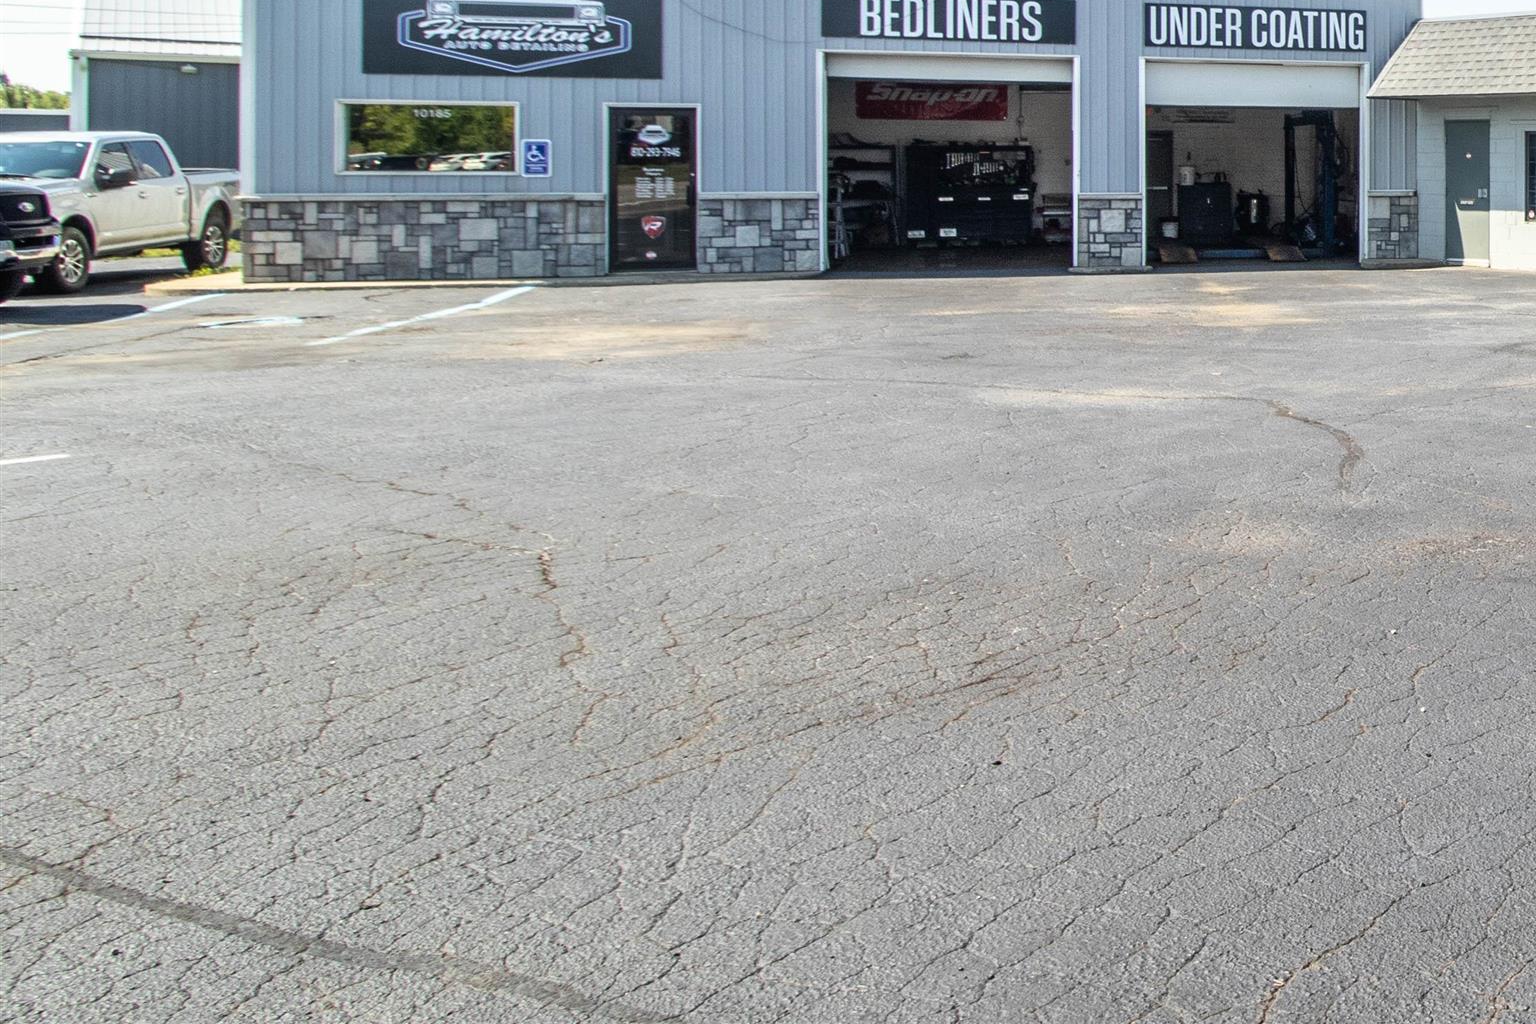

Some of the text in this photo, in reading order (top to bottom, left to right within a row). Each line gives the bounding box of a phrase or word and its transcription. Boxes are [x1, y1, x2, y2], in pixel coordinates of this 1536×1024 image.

[418, 19, 614, 43] Hamilton's
[1149, 6, 1365, 51] UNDER COATING
[443, 40, 590, 53] AUTO DETAILING
[866, 82, 998, 106] Snap-on
